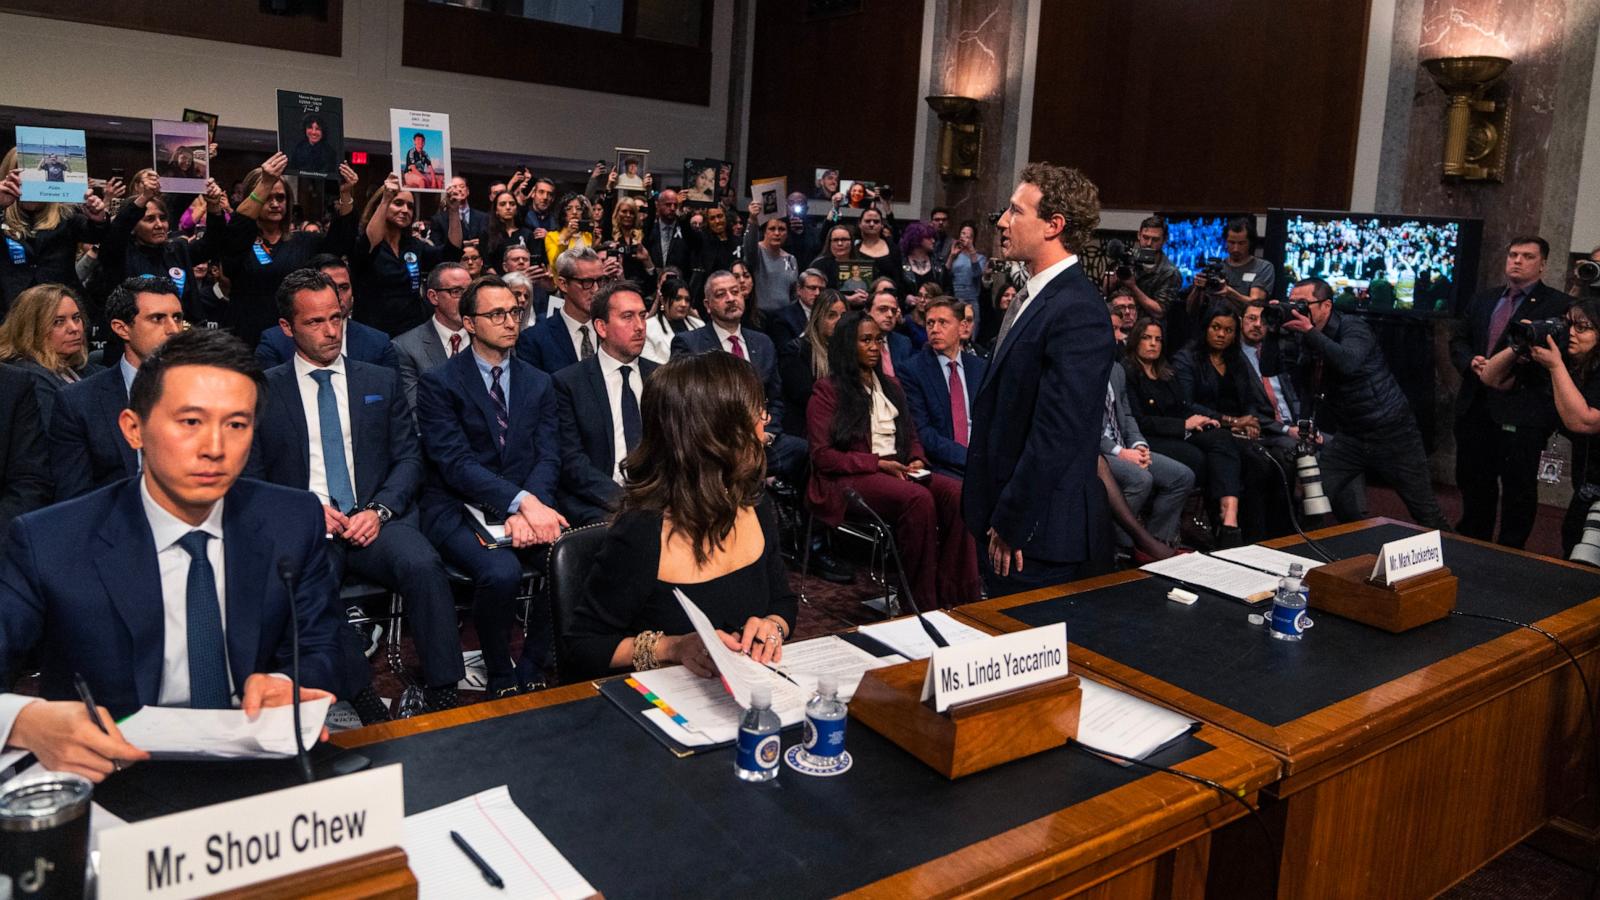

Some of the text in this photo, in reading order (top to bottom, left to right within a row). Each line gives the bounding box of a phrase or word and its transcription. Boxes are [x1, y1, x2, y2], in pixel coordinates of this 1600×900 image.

[1389, 545, 1439, 571] Mr. Mark Zuckerberg
[941, 645, 1061, 693] Ms. Linda Yaccarino
[147, 810, 366, 891] Mr. Shou Chew
